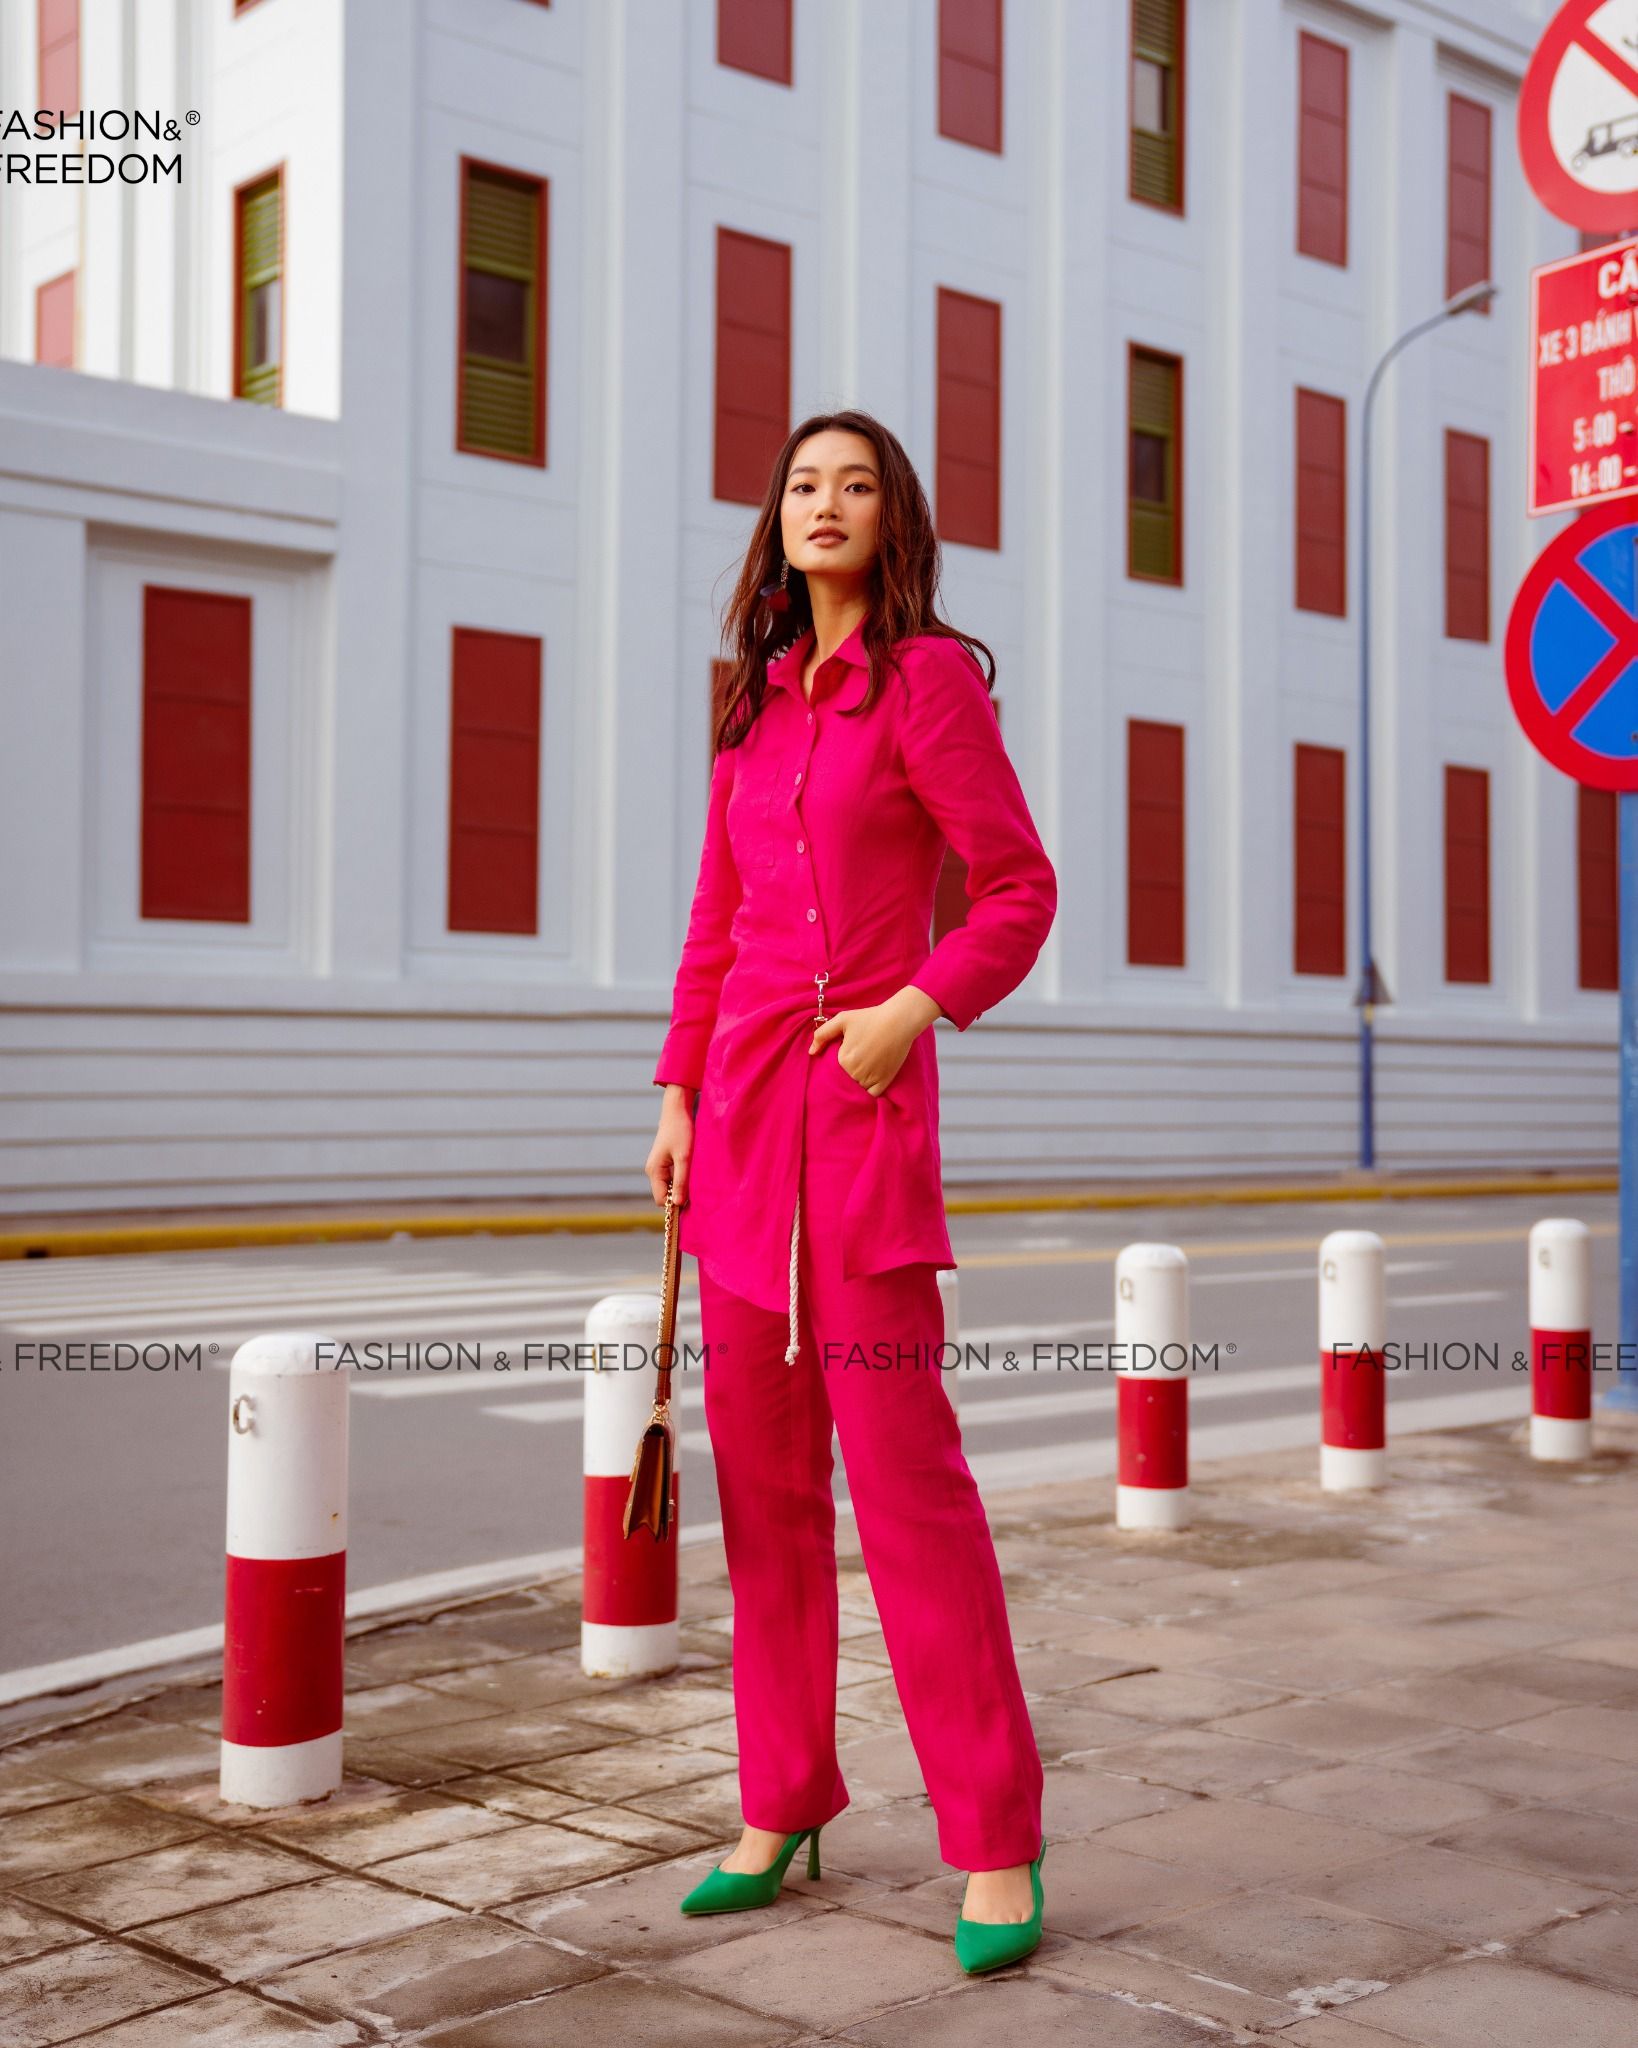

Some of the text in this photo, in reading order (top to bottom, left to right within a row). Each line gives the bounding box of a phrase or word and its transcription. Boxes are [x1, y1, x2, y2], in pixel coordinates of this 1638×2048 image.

[1539, 330, 1564, 368] XE
[1565, 325, 1579, 360] 3
[1581, 308, 1632, 356] BÁNH
